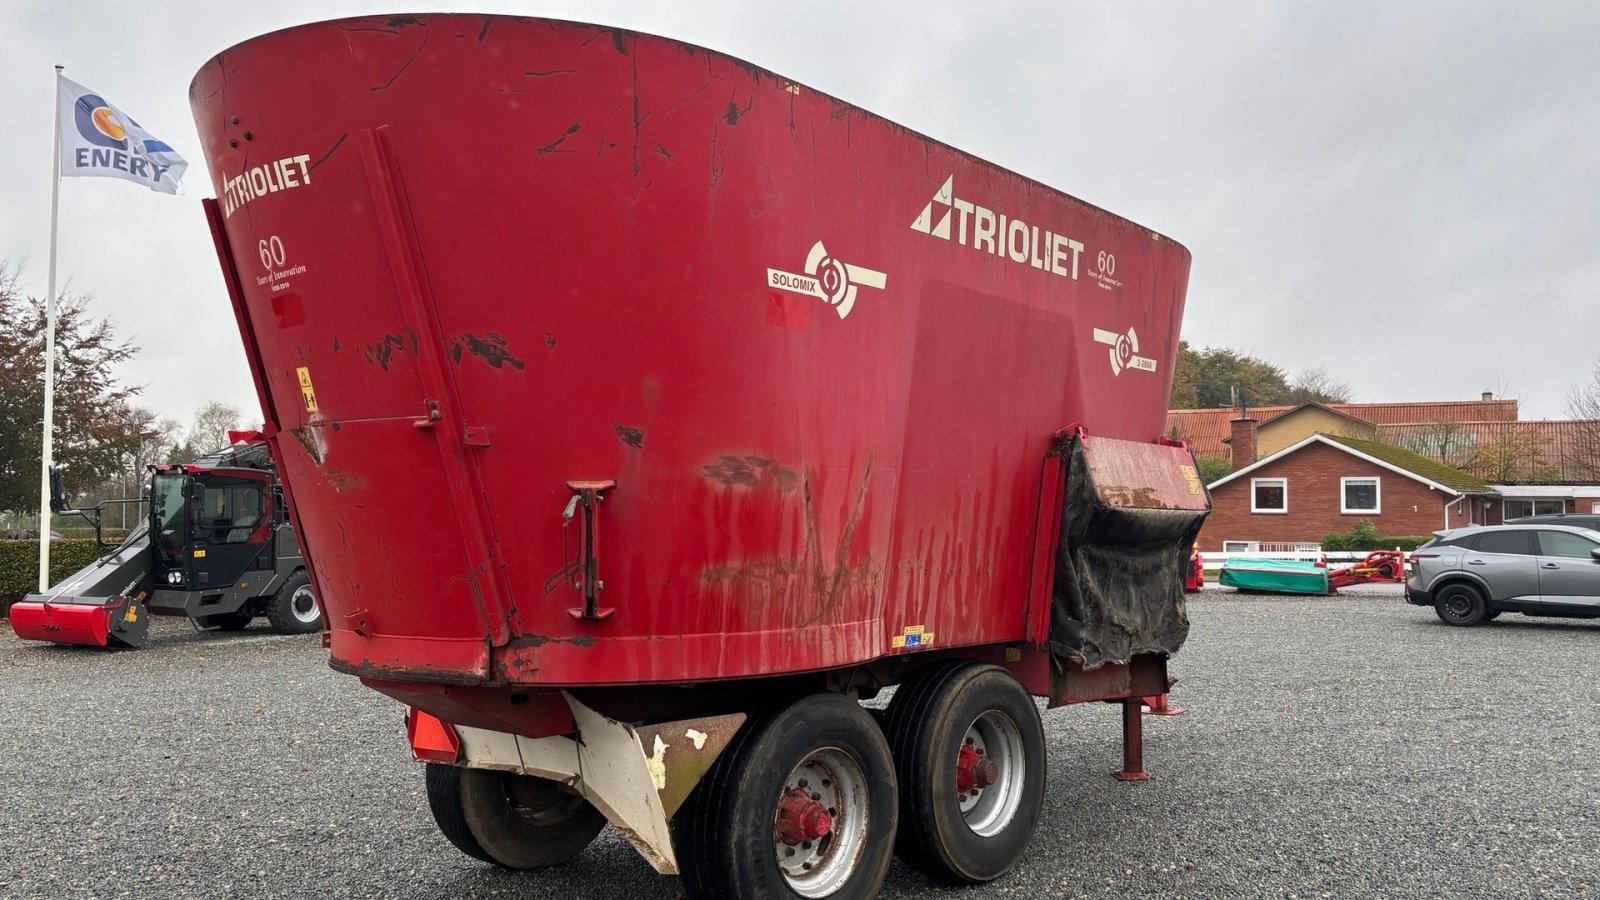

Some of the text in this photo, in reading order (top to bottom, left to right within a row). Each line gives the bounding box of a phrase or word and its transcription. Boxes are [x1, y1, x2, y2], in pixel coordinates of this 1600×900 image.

[228, 154, 311, 209] TRIOLIET
[258, 235, 286, 270] 60
[953, 196, 1085, 281] TRIOLIET
[1097, 250, 1115, 276] 60
[772, 272, 816, 293] SOLOMIX
